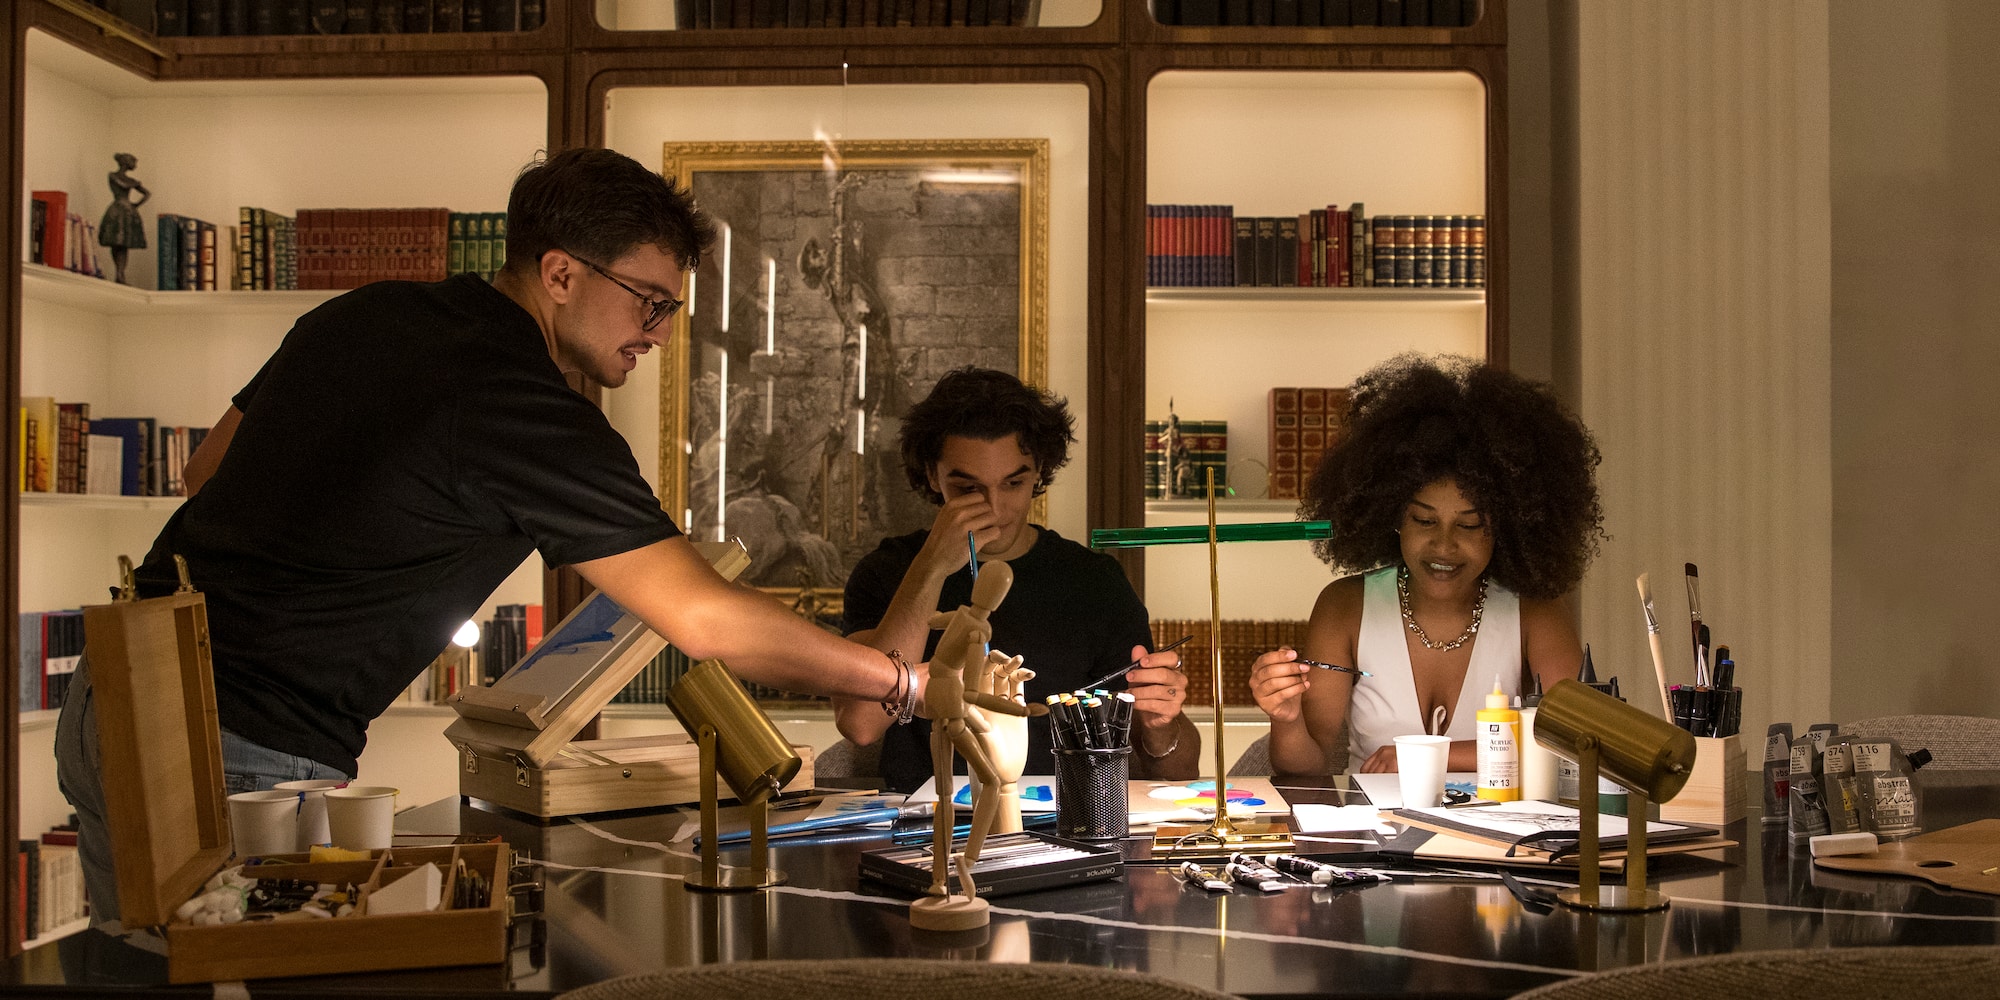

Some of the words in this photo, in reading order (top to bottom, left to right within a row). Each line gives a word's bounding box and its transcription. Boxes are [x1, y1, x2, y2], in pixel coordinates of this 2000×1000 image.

[1793, 747, 1805, 756] 759
[1858, 745, 1878, 754] 116
[1500, 779, 1510, 787] 13
